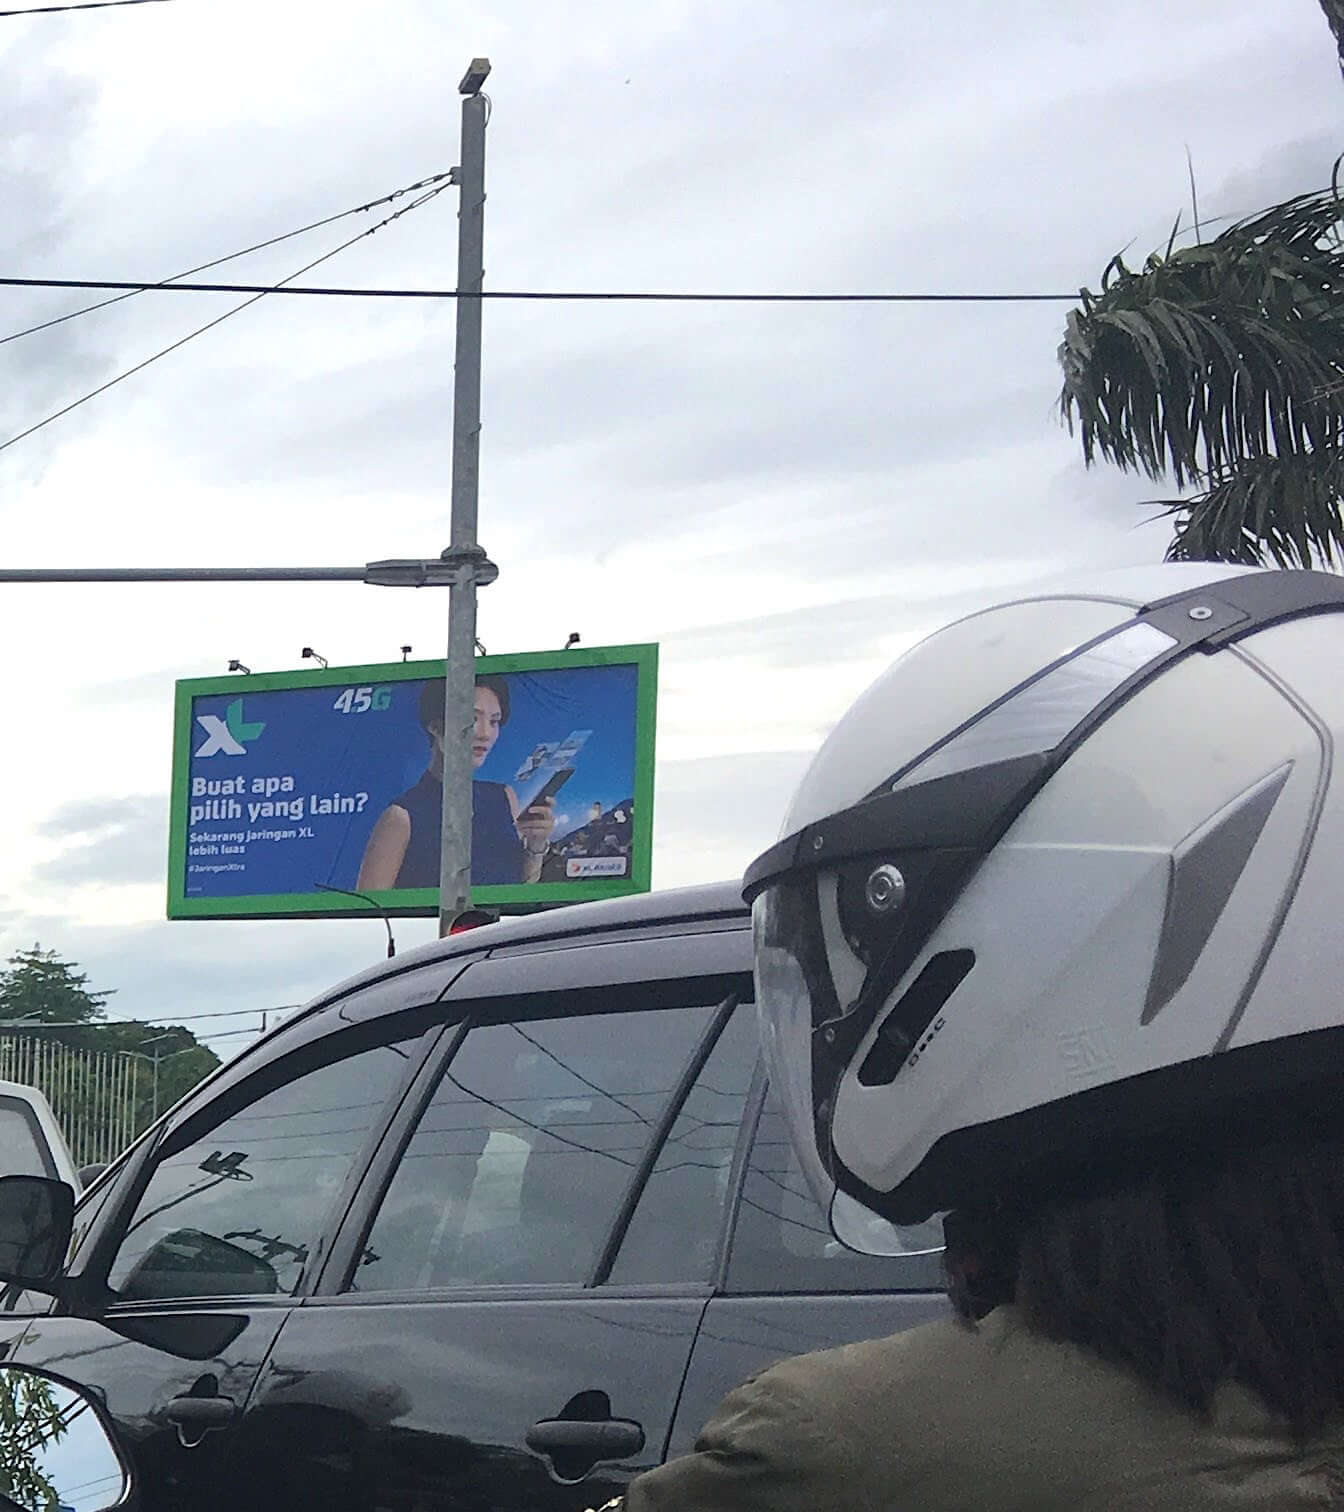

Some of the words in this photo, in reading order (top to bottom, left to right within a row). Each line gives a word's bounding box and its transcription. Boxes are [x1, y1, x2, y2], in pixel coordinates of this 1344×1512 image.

[194, 699, 266, 757] XL
[192, 776, 245, 796] Buat
[252, 776, 295, 797] apa
[189, 798, 241, 826] pilih
[243, 797, 304, 823] yang
[310, 792, 369, 815] lain?
[190, 831, 244, 843] Sekarang
[245, 829, 297, 843] jaringan
[298, 827, 315, 838] XL
[189, 844, 219, 856] lebih
[220, 844, 246, 854] luas
